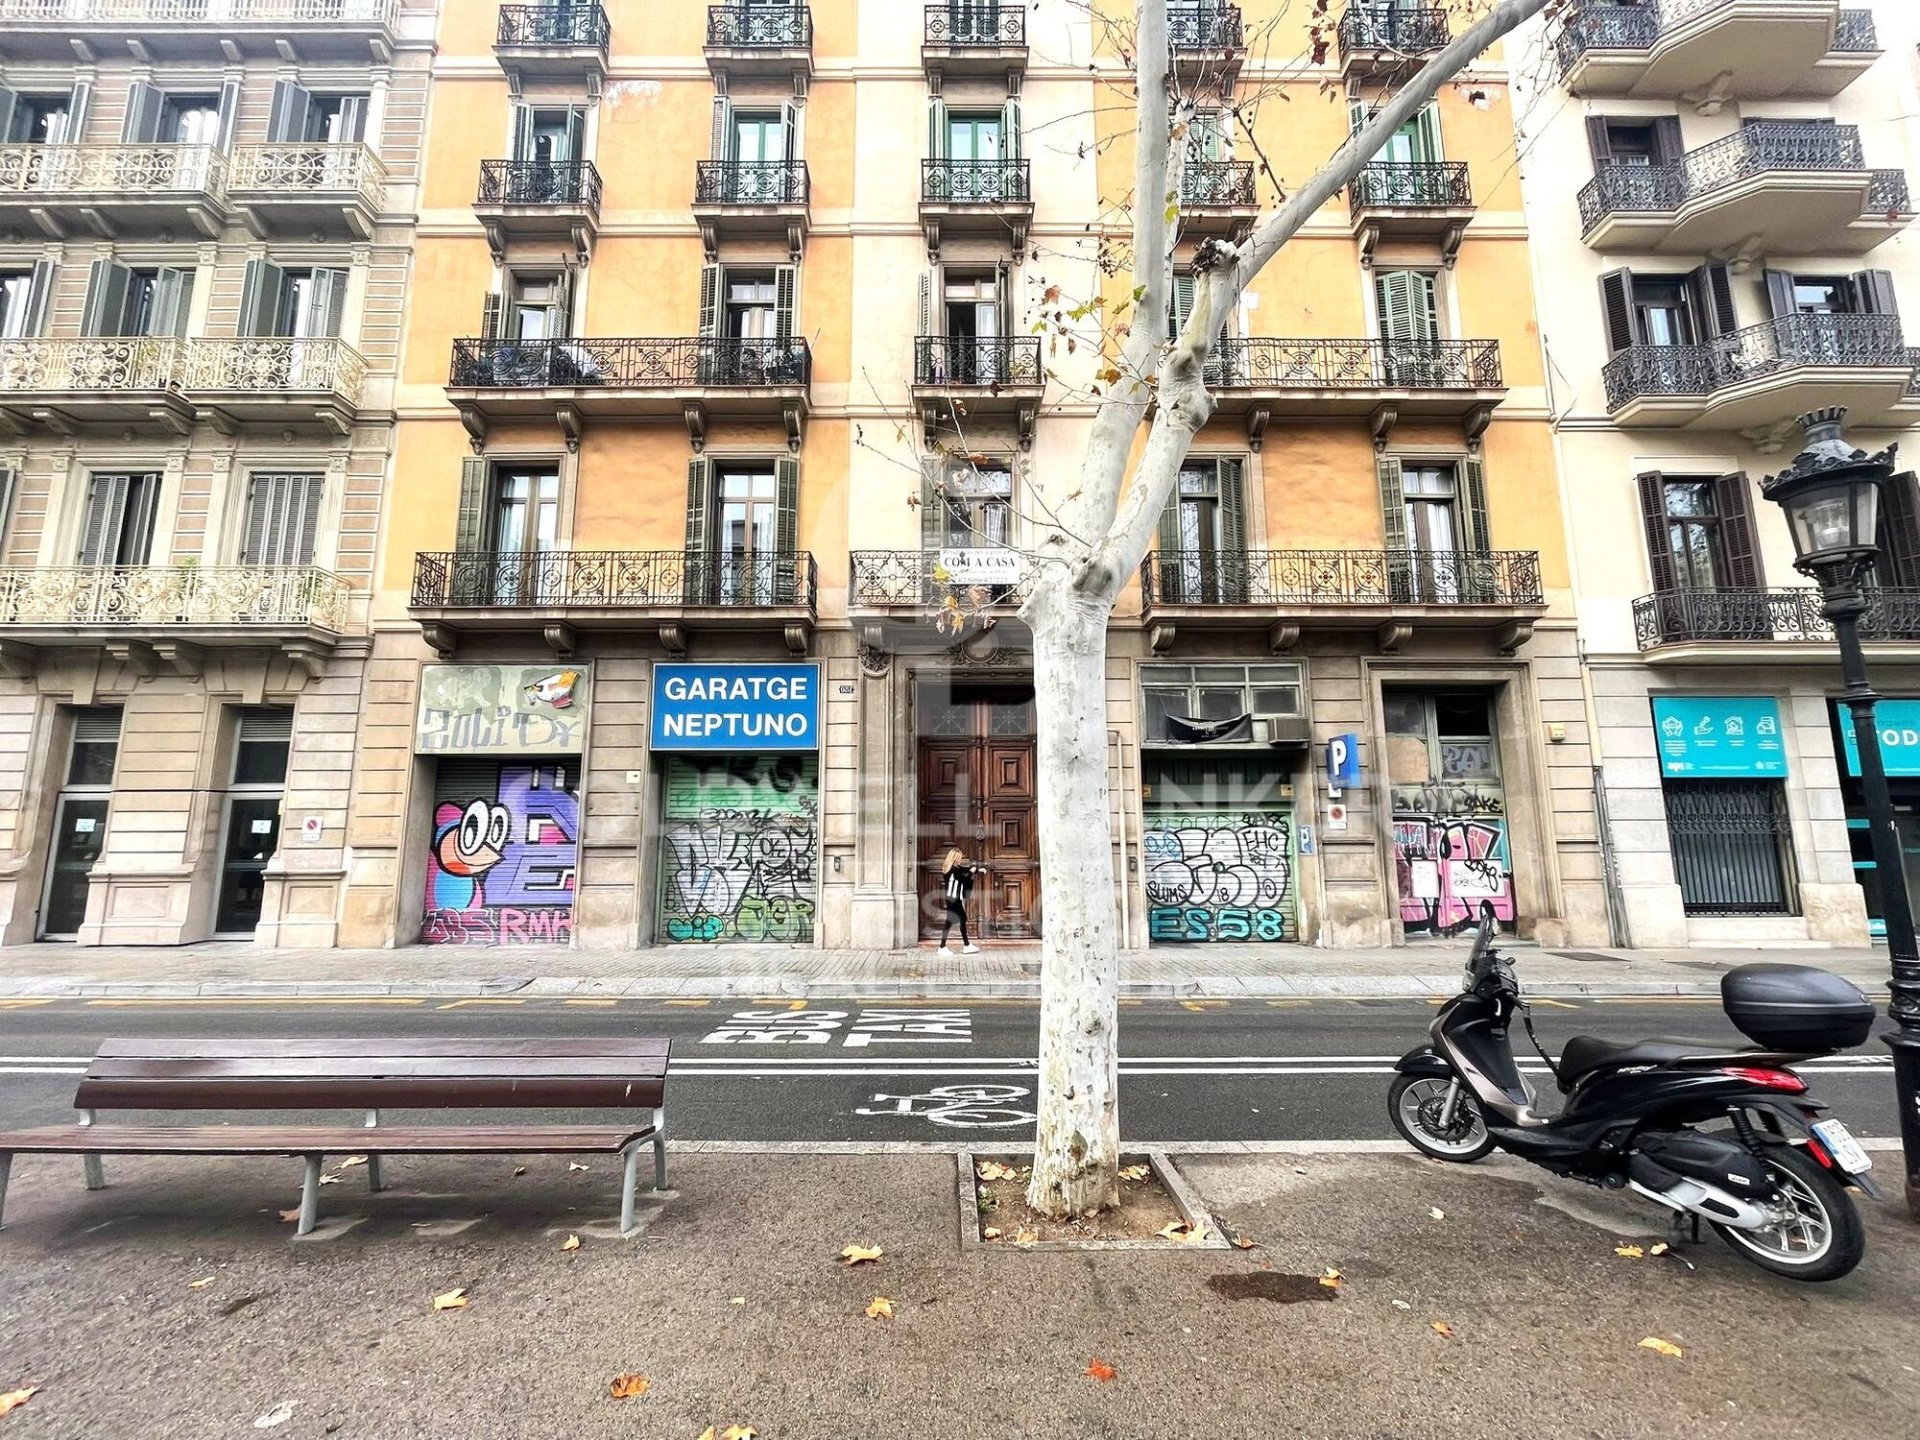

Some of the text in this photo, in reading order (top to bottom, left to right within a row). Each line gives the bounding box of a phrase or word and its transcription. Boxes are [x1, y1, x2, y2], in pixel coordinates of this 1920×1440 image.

[975, 557, 982, 567] A
[986, 557, 1015, 567] CASA
[664, 677, 807, 701] GARATGE
[663, 713, 807, 737] NEPTUNO
[1331, 740, 1347, 776] P
[1147, 881, 1187, 902] SLUMS
[699, 1008, 972, 1047] BUS TAXI
